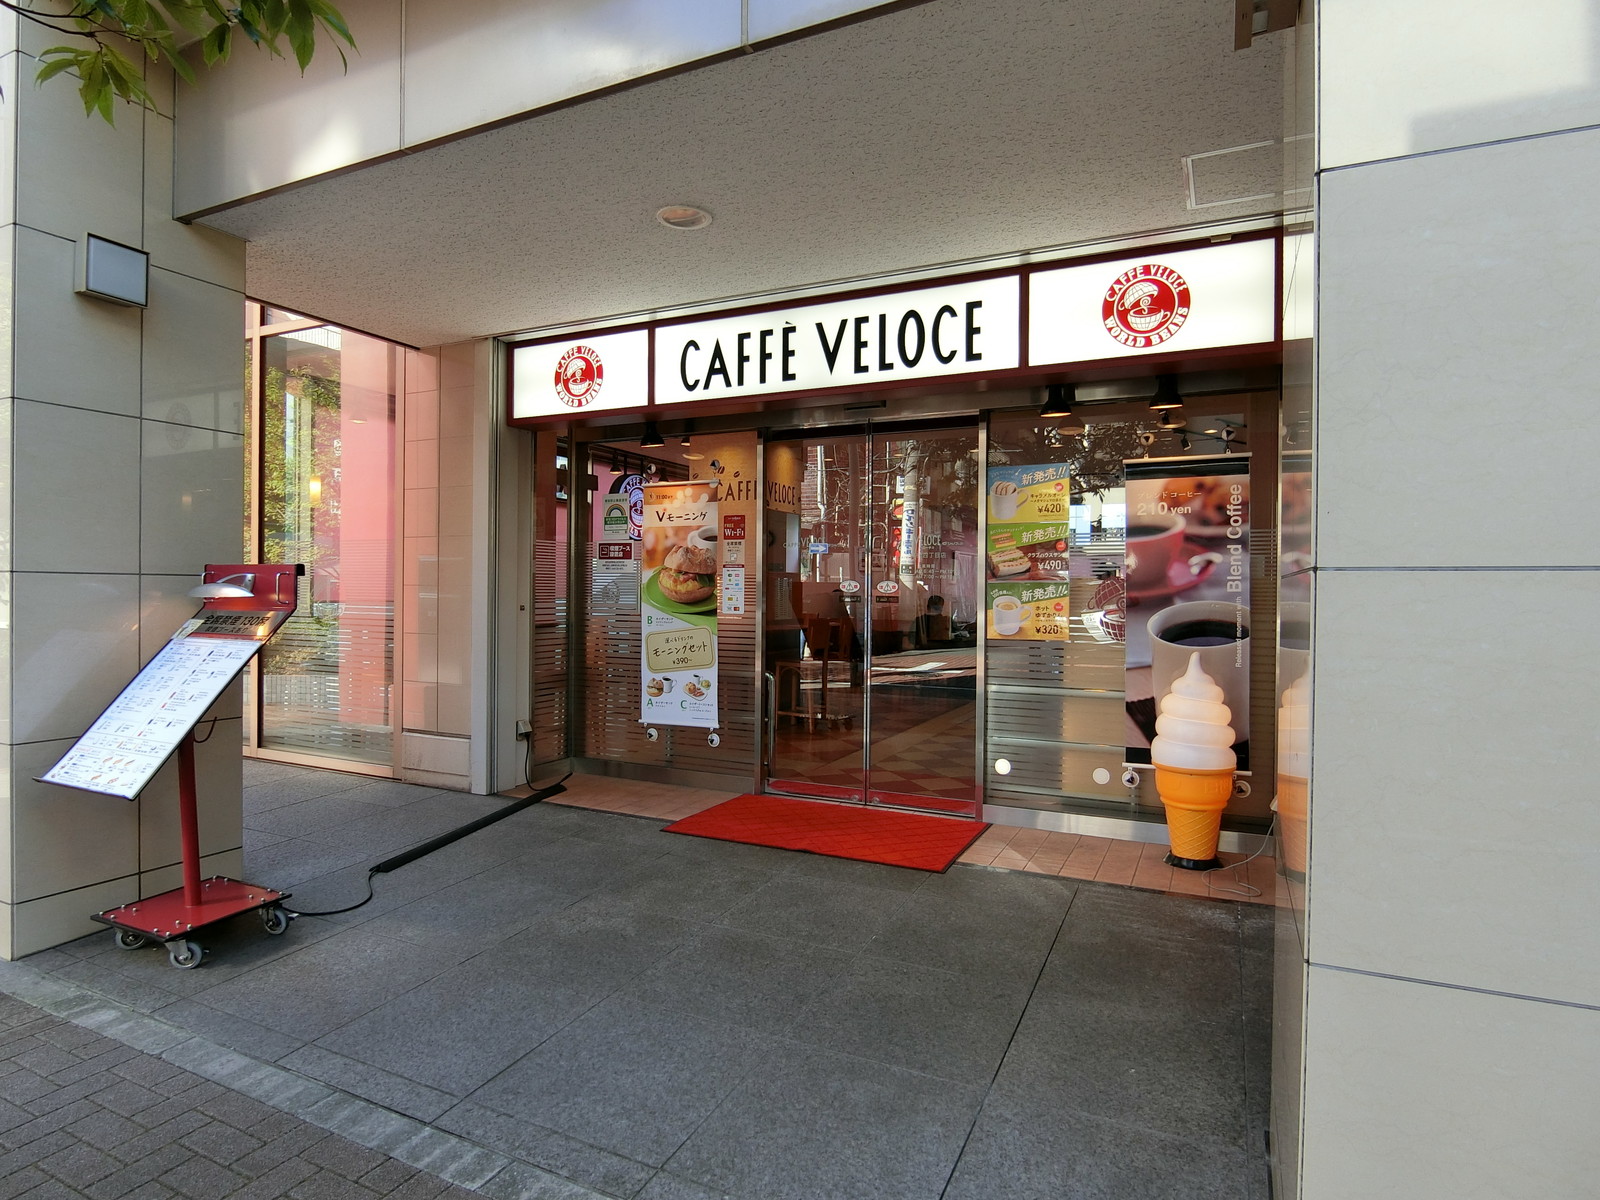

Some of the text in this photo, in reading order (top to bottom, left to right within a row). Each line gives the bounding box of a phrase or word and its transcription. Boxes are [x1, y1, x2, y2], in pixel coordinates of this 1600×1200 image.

[1149, 264, 1188, 293] VELOCE
[1104, 306, 1188, 347] WORLD BEANS
[680, 300, 983, 392] CAFFÈ VELOCE
[767, 480, 796, 506] VELOCE
[1037, 503, 1061, 513] ¥420
[1137, 501, 1191, 516] 210 yen
[1226, 484, 1242, 539] Coffee
[1038, 560, 1062, 570] ¥490
[1226, 544, 1242, 593] Blend
[647, 615, 653, 625] B
[1035, 625, 1059, 635] ¥320
[653, 641, 708, 657] モーニングセット
[646, 698, 654, 707] A
[680, 700, 687, 709] C
